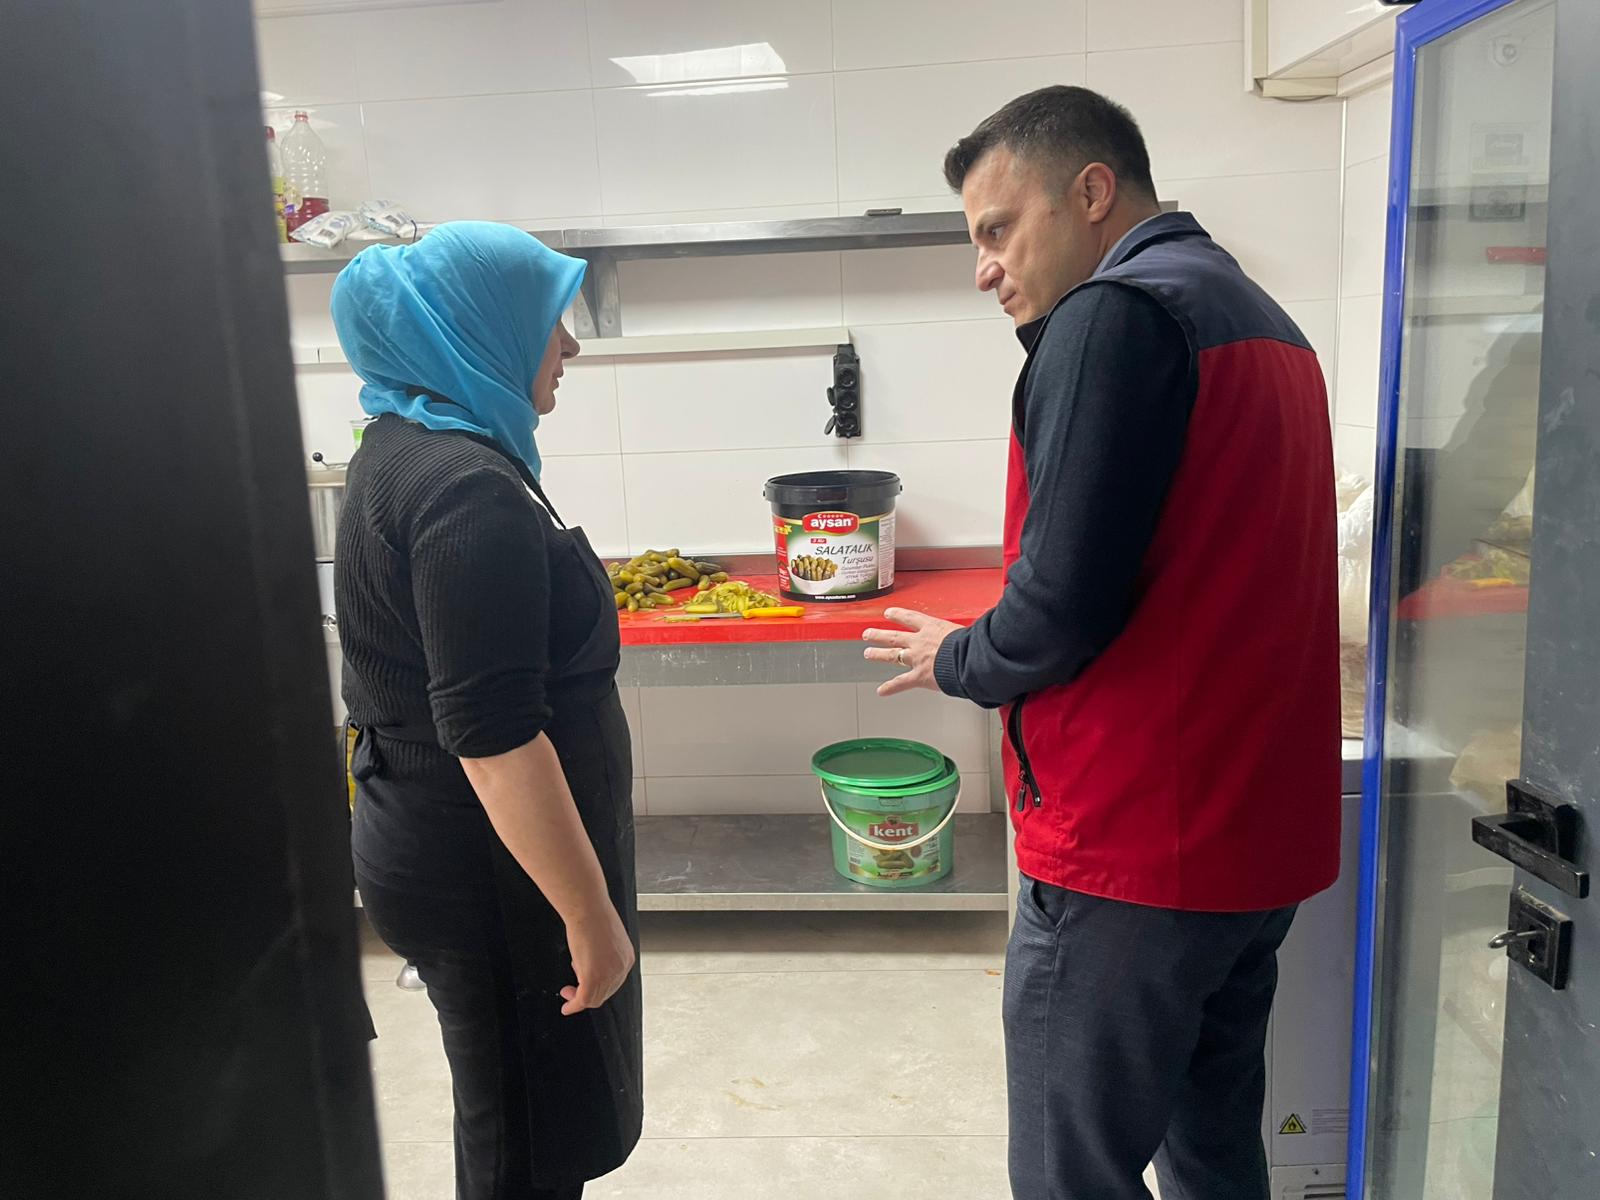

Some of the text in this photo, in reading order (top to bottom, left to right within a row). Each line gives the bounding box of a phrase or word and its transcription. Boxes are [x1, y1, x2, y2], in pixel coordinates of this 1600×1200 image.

[811, 518, 851, 529] aysan
[815, 544, 873, 555] SALATALIK
[874, 825, 913, 837] kent
